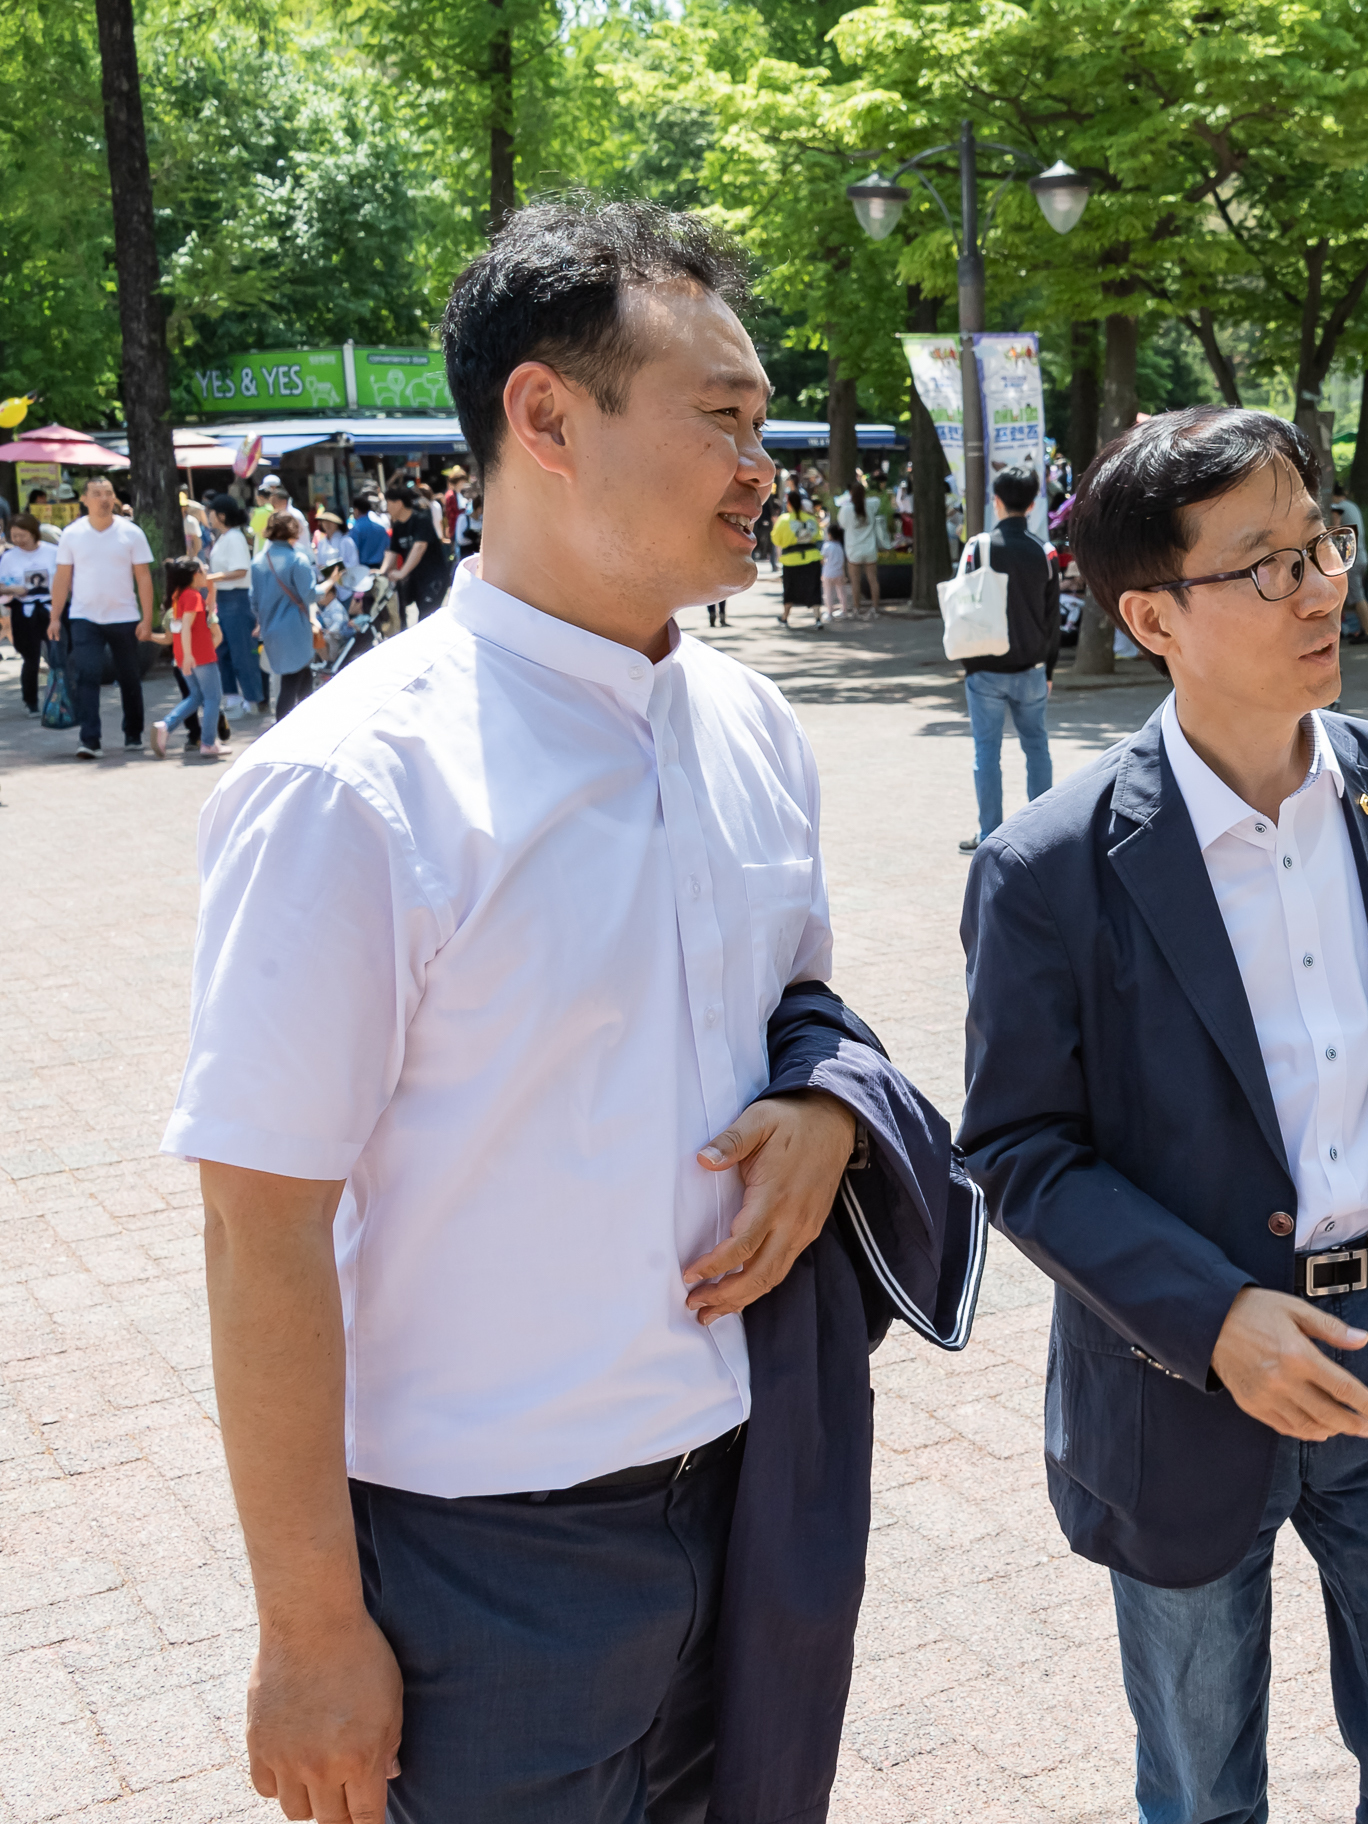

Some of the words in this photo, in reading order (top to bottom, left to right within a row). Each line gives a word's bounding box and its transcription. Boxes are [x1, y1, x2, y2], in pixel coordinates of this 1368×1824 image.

[196, 369, 236, 399] YES
[241, 367, 258, 397] &
[261, 365, 304, 396] YES
[994, 424, 1039, 443] 프렌즈
